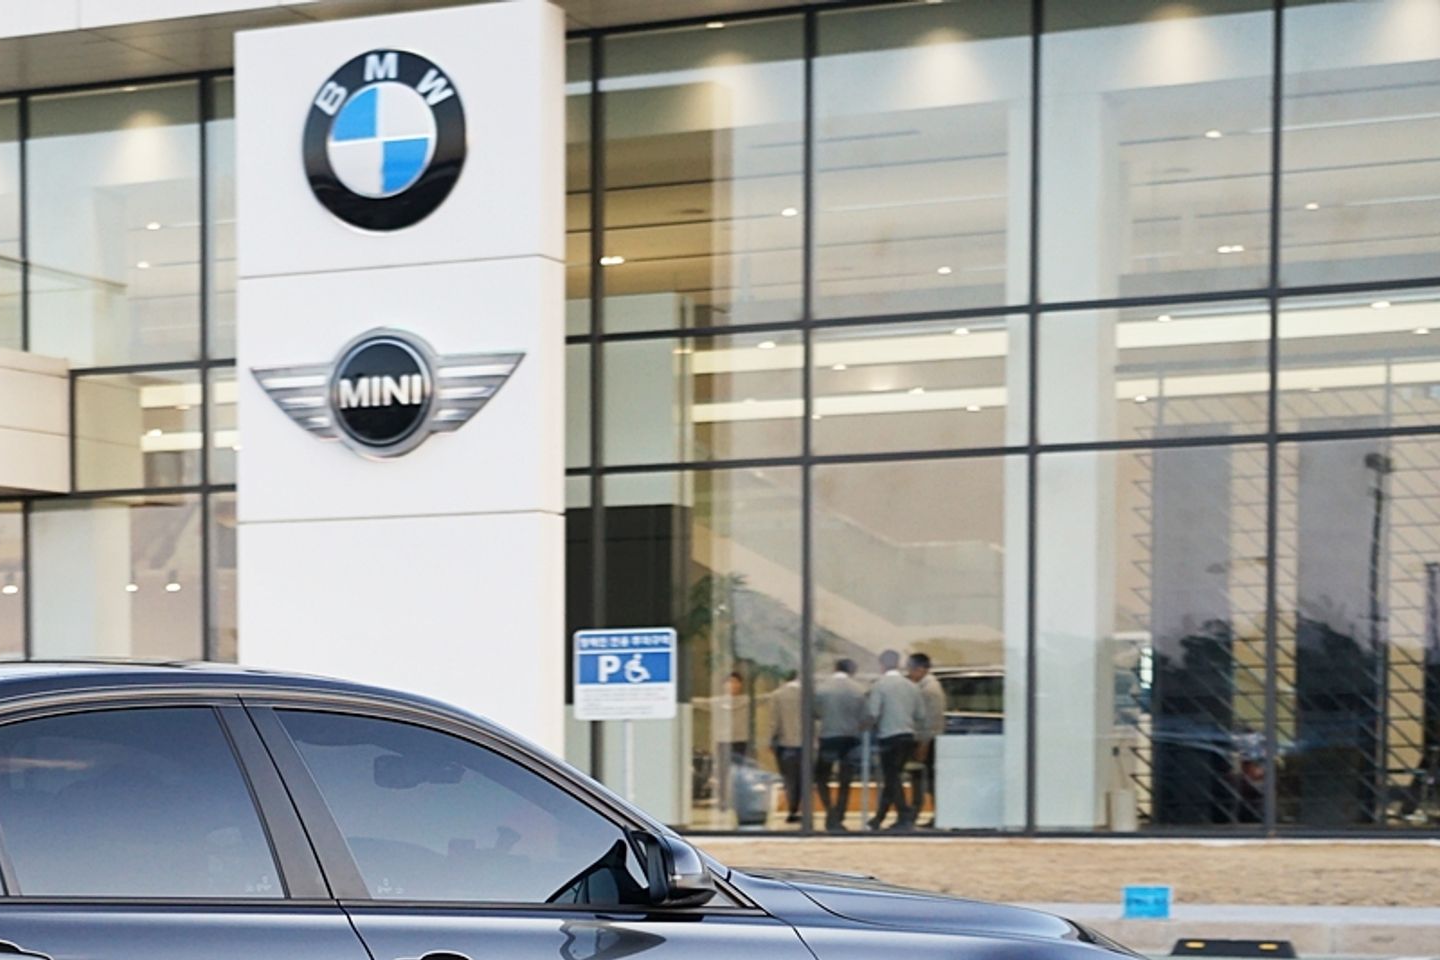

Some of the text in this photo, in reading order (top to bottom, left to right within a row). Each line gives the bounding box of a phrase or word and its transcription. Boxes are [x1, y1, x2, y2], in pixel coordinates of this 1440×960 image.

[315, 52, 453, 116] BMW
[339, 374, 422, 409] MINI
[598, 655, 621, 683] P
